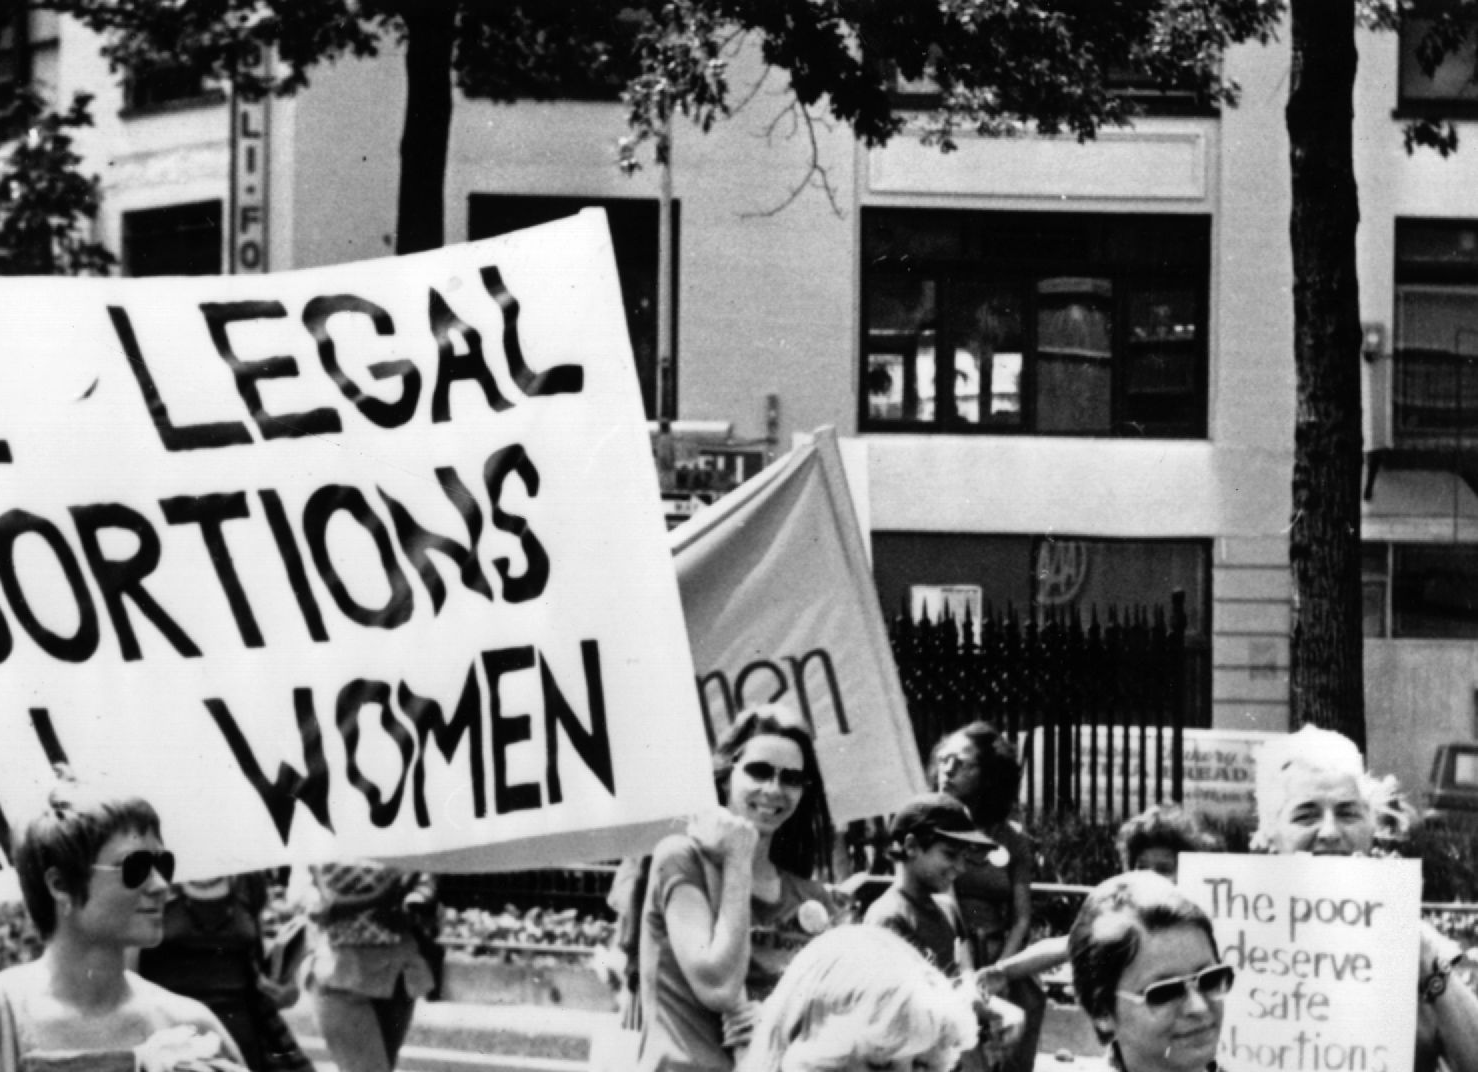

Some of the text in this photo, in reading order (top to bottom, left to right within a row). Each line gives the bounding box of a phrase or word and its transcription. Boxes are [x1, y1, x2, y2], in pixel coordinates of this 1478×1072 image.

[106, 265, 584, 452] LEGAL
[202, 639, 616, 848] WOMEN
[1203, 876, 1384, 943] The poor
[1222, 930, 1373, 983] deserve
[1247, 981, 1330, 1021] safe
